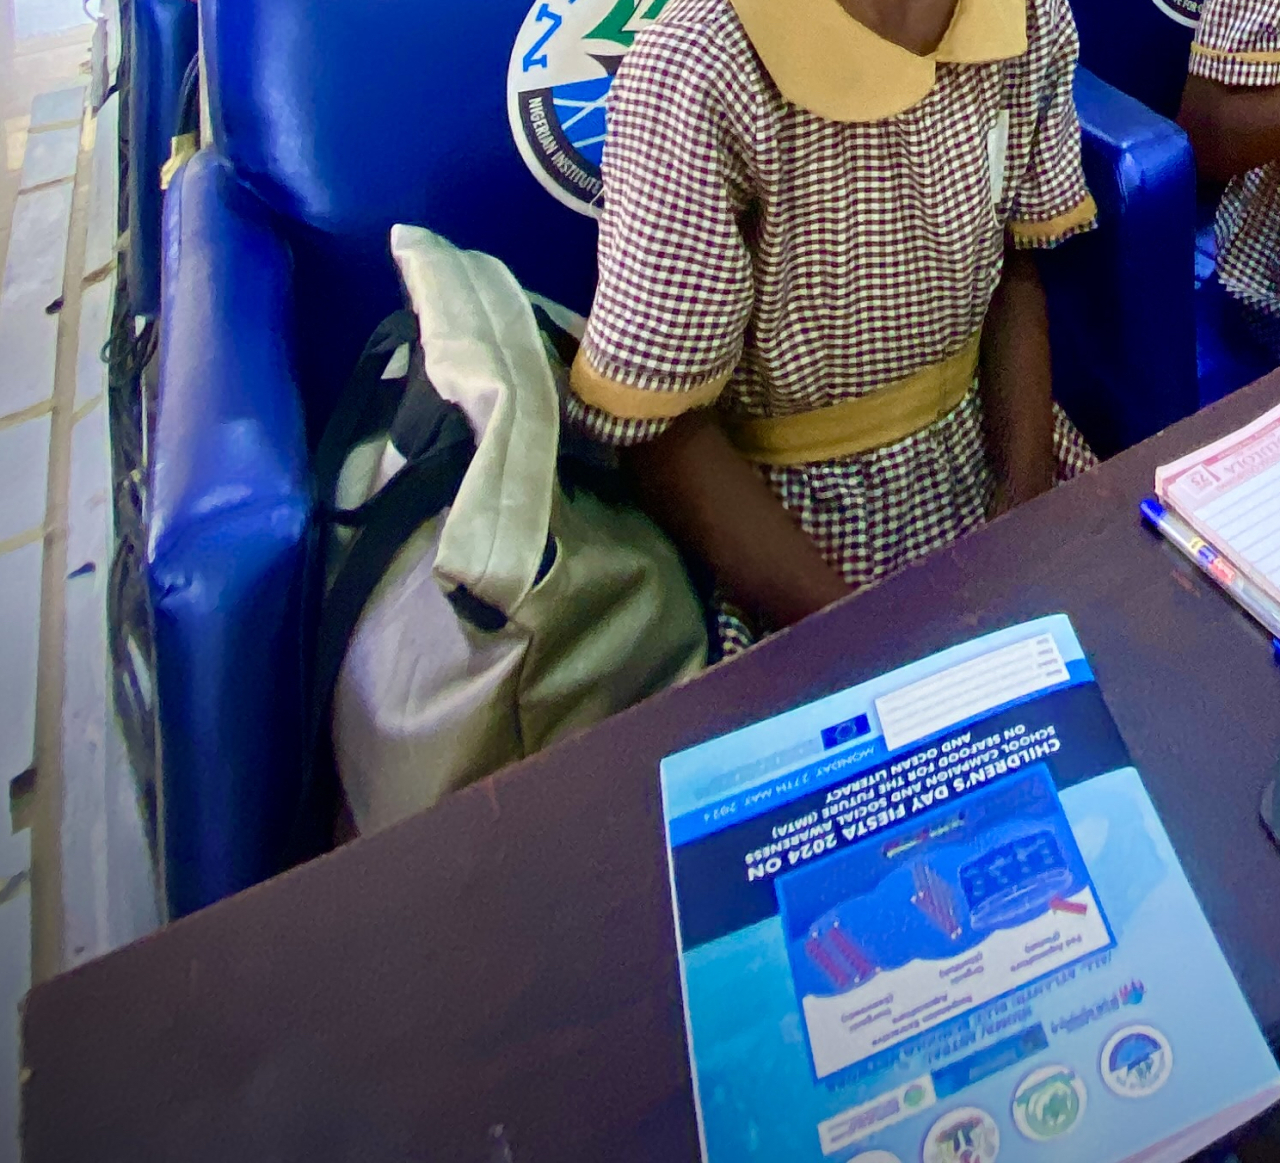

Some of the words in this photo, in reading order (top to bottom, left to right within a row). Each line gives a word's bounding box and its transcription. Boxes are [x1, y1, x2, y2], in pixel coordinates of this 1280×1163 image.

[528, 96, 559, 155] NIGERIAN
[941, 730, 971, 753] AND
[1001, 725, 1056, 754] SCHOOL
[1003, 724, 1026, 740] ON
[816, 746, 875, 777] MONDAY
[890, 747, 938, 777] OCEAN
[938, 733, 1001, 768] SEAFOOD
[952, 738, 1061, 793] CHILDREN'S
[907, 762, 935, 782] FOR
[925, 748, 1000, 788] CAMPAIGN
[825, 769, 888, 804] LITERACY
[878, 776, 905, 795] THE
[890, 781, 922, 803] AND
[911, 784, 949, 813] DAY
[821, 787, 875, 819] FUTURE
[836, 796, 888, 826] SOCIAL
[771, 811, 819, 839] (IMTA)
[841, 803, 907, 842] FIESTA
[744, 819, 833, 865] AWARENESS
[787, 832, 838, 866] 2024
[747, 856, 783, 883] ON
